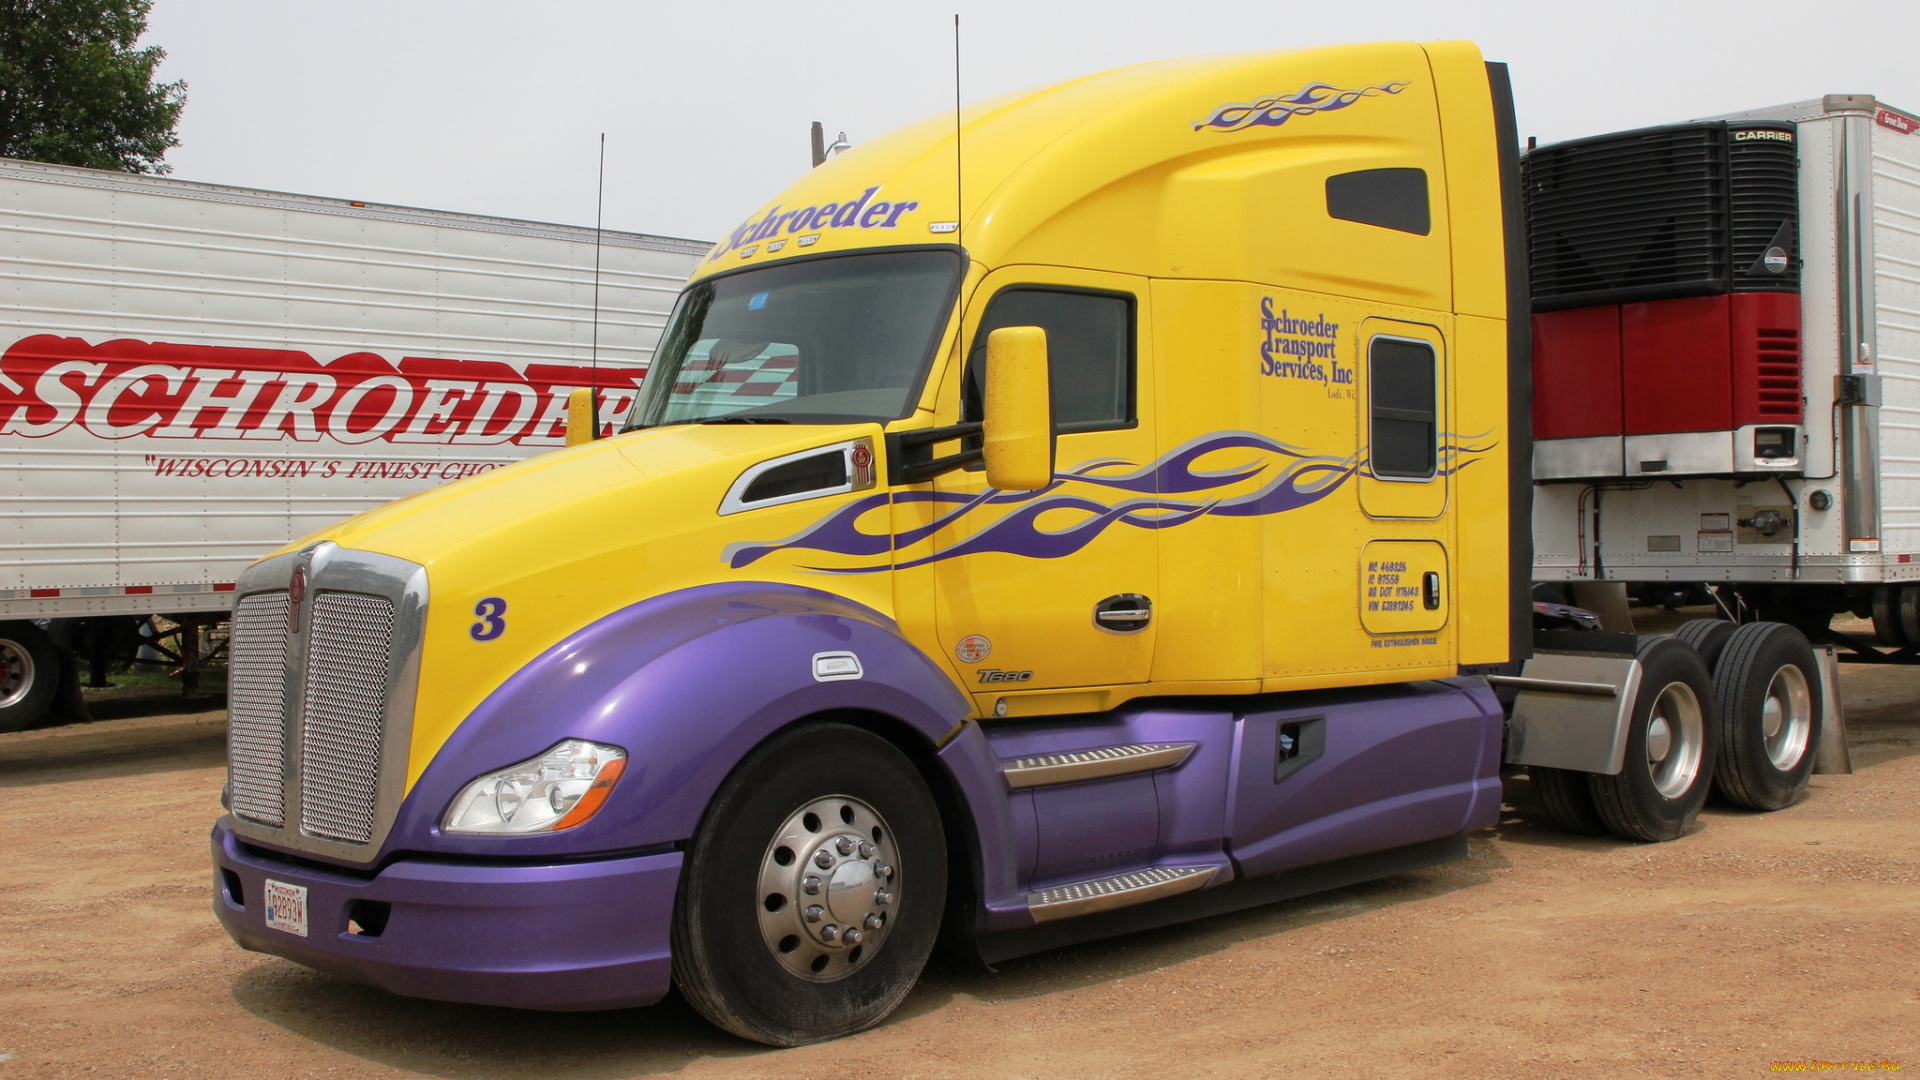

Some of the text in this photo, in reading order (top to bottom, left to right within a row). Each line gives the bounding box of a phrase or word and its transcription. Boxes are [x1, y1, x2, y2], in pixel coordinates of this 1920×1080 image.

[709, 185, 919, 263] Schroeder
[1260, 296, 1339, 339] Schroeder
[1261, 317, 1337, 364] Transport
[1260, 341, 1353, 387] Services, Inc
[0, 357, 642, 446] SCHROEDER
[345, 461, 439, 480] FINEST
[1380, 587, 1393, 597] DOT
[470, 596, 508, 643] 3
[1384, 638, 1420, 647] EXTINGUISHER
[977, 669, 1034, 683] T680
